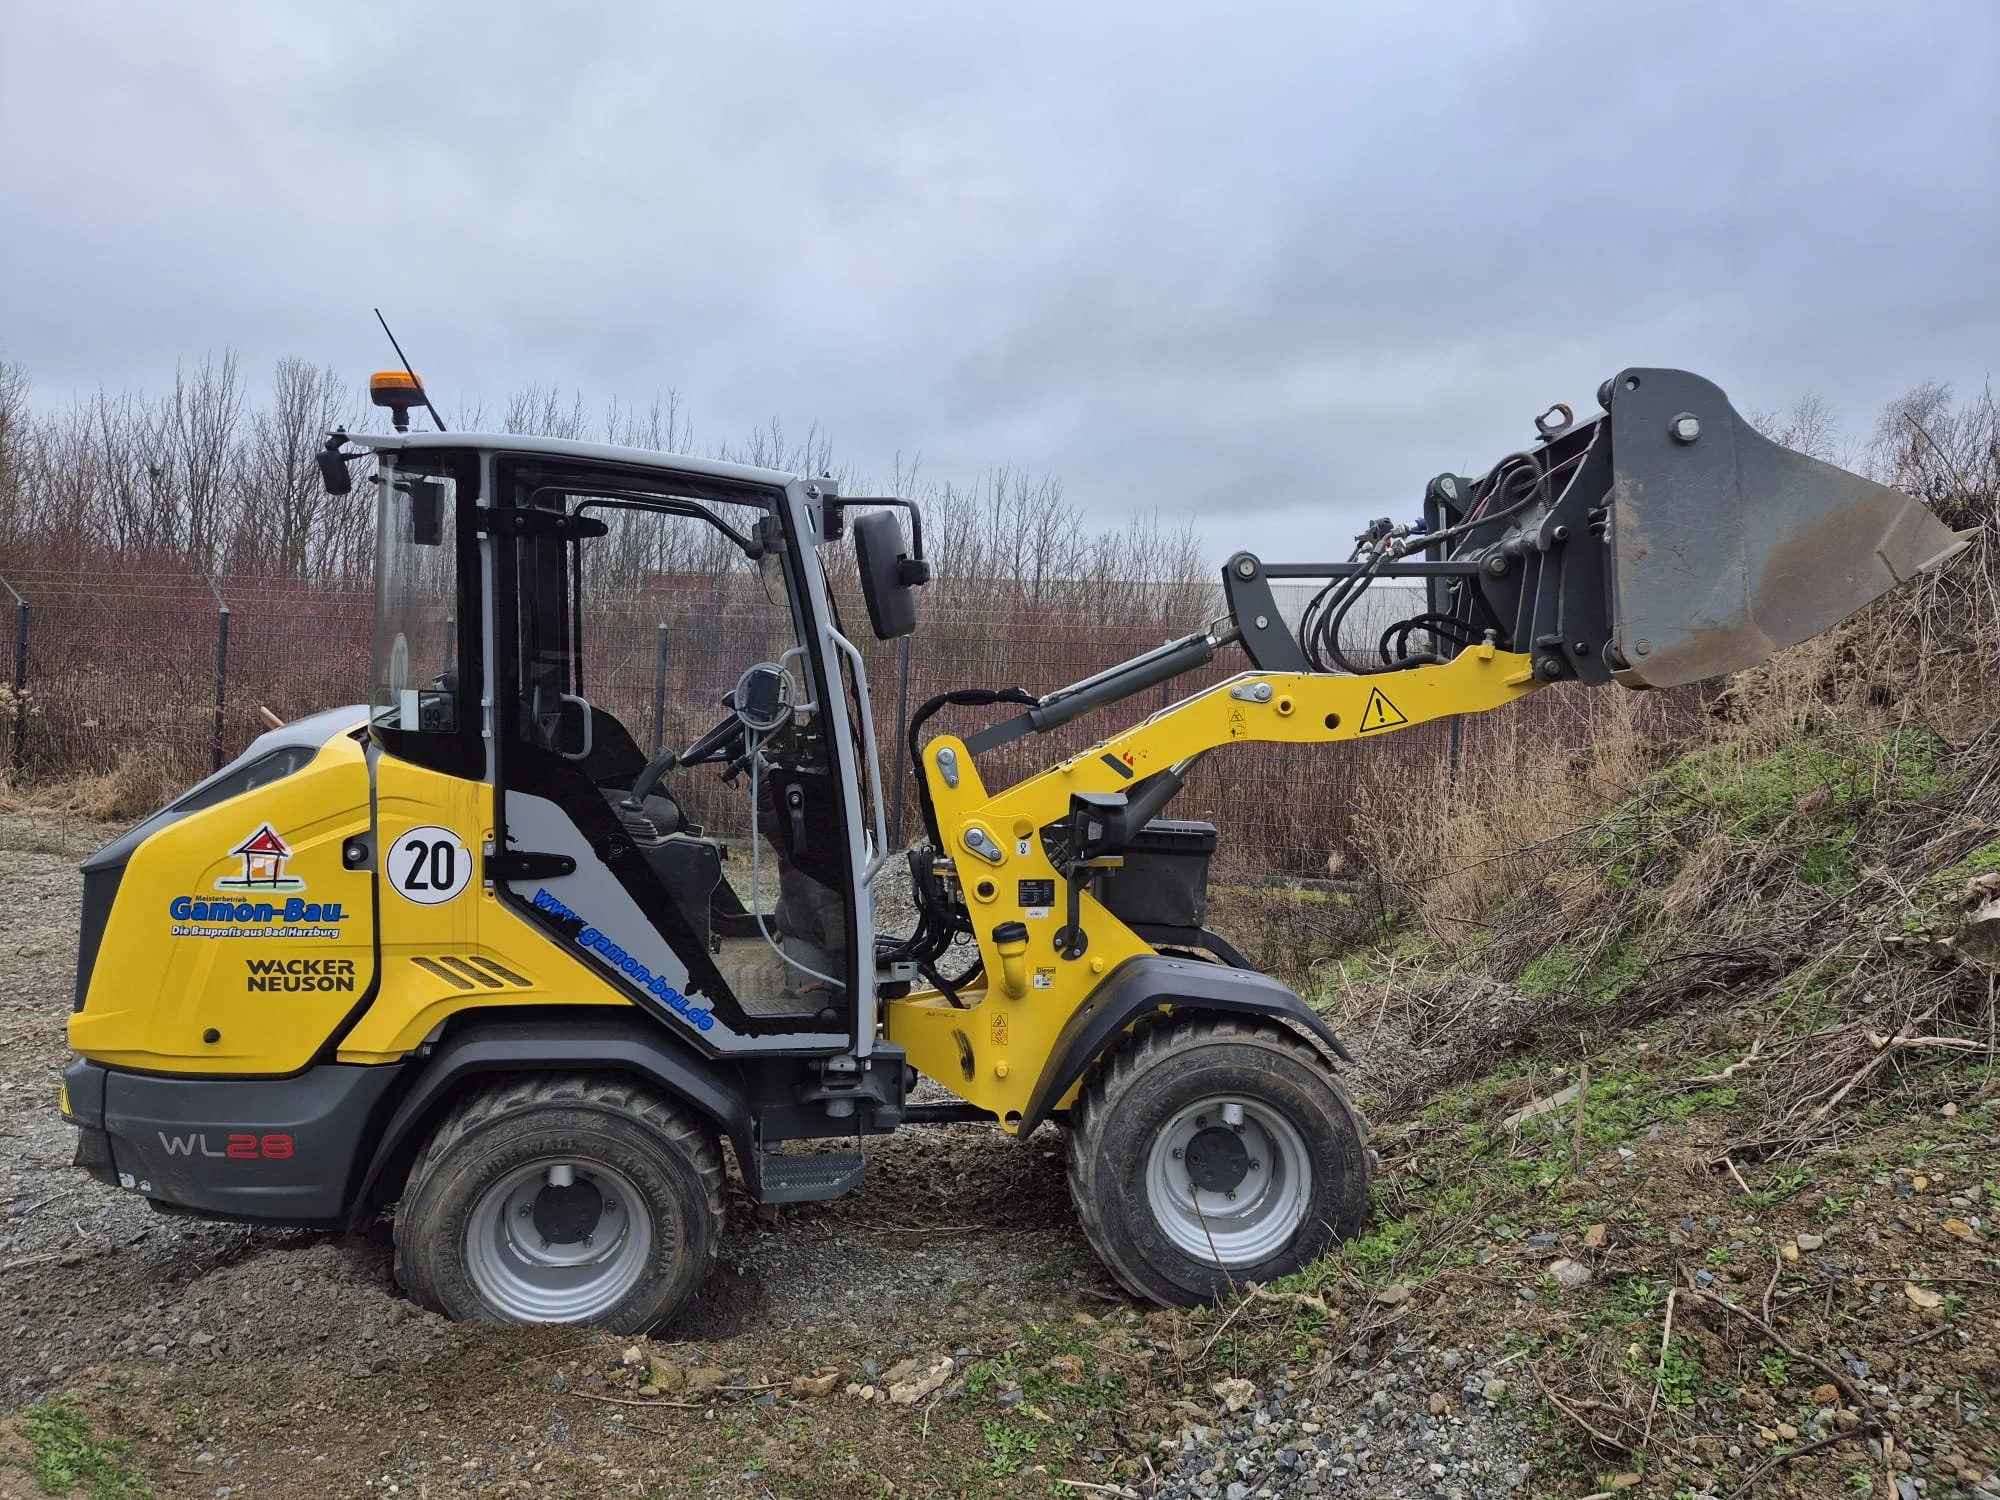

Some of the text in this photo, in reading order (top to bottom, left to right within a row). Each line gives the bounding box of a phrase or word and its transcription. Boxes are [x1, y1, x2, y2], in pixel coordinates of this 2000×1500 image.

[404, 839, 455, 891] 20
[169, 896, 342, 923] Gamon-Bau
[195, 895, 248, 903] Meisterbetrieb
[171, 925, 340, 940] Die Bauprofis aus Bad Harzburg
[246, 959, 356, 975] WACKER
[533, 887, 714, 1031] ww.gamon-bau.de
[247, 976, 354, 992] NEUSON
[158, 1131, 295, 1159] WL28
